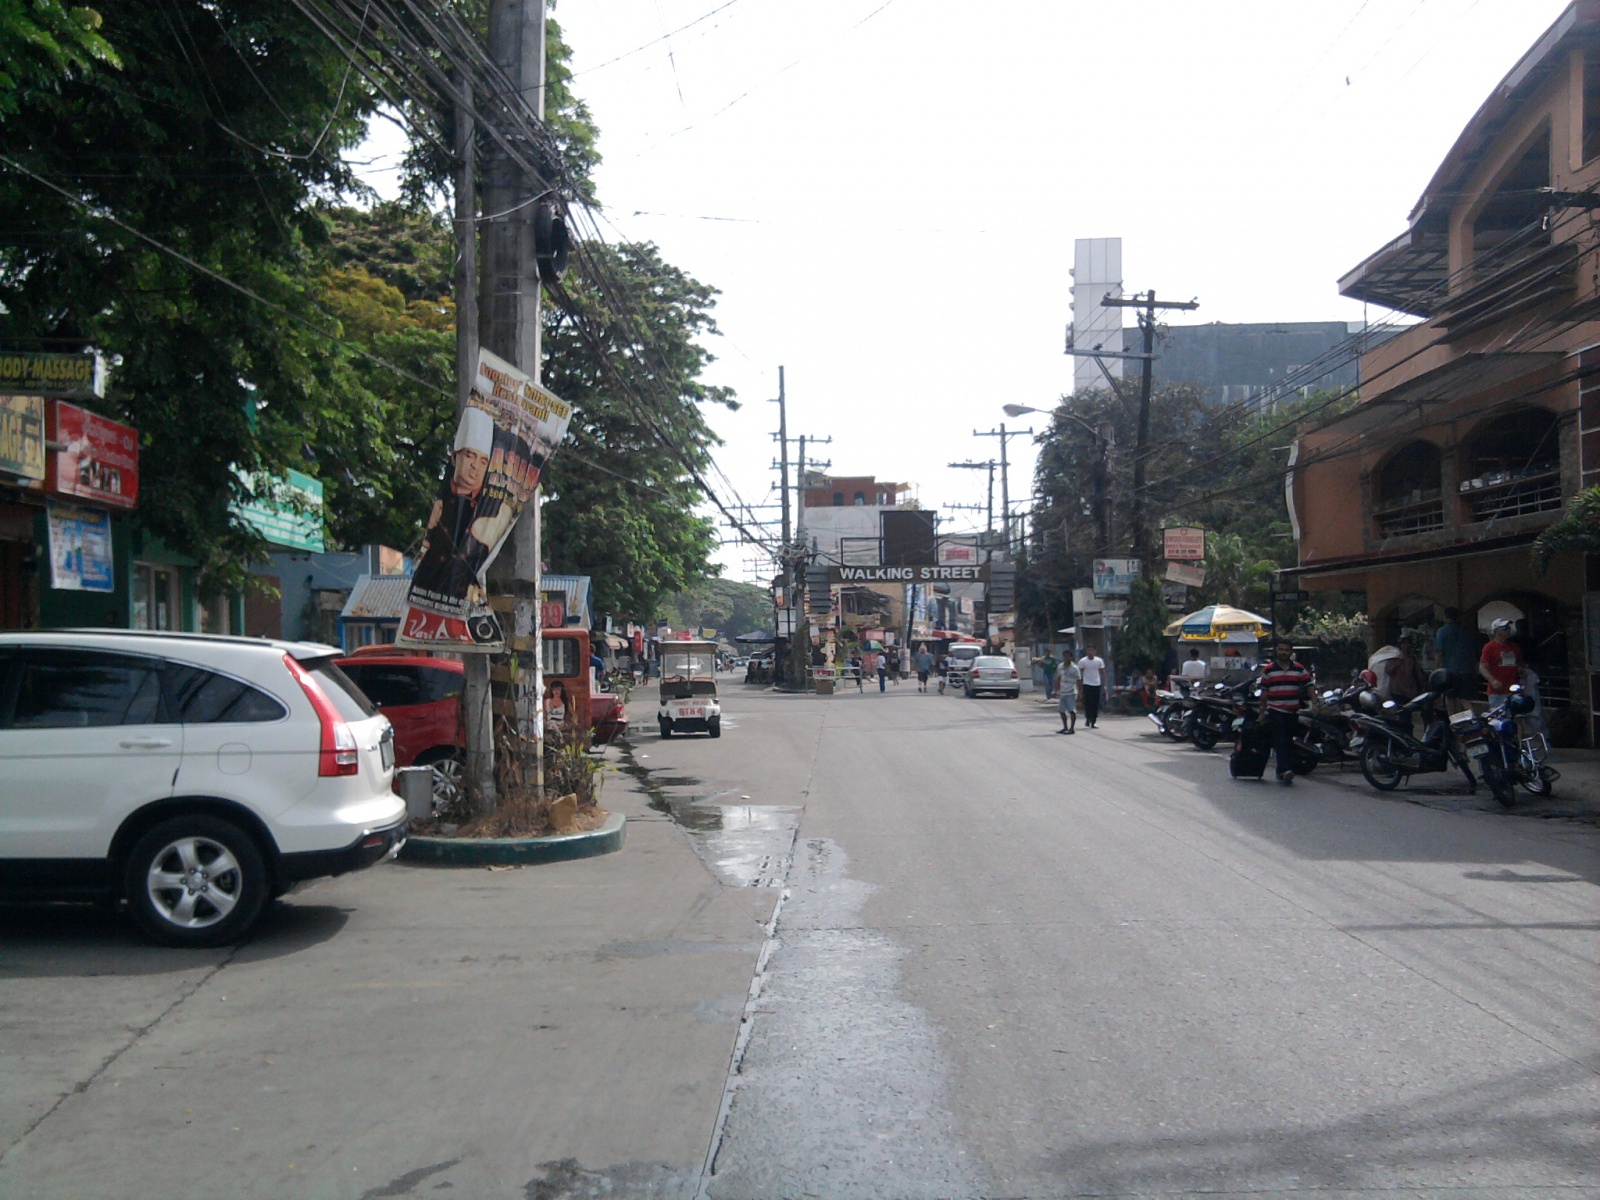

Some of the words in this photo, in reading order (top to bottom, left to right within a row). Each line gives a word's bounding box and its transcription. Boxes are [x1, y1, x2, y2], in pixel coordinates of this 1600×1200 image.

[0, 357, 30, 379] ODY
[32, 358, 92, 381] MASSAGE
[840, 567, 914, 580] WALKING
[920, 566, 982, 580] STREET
